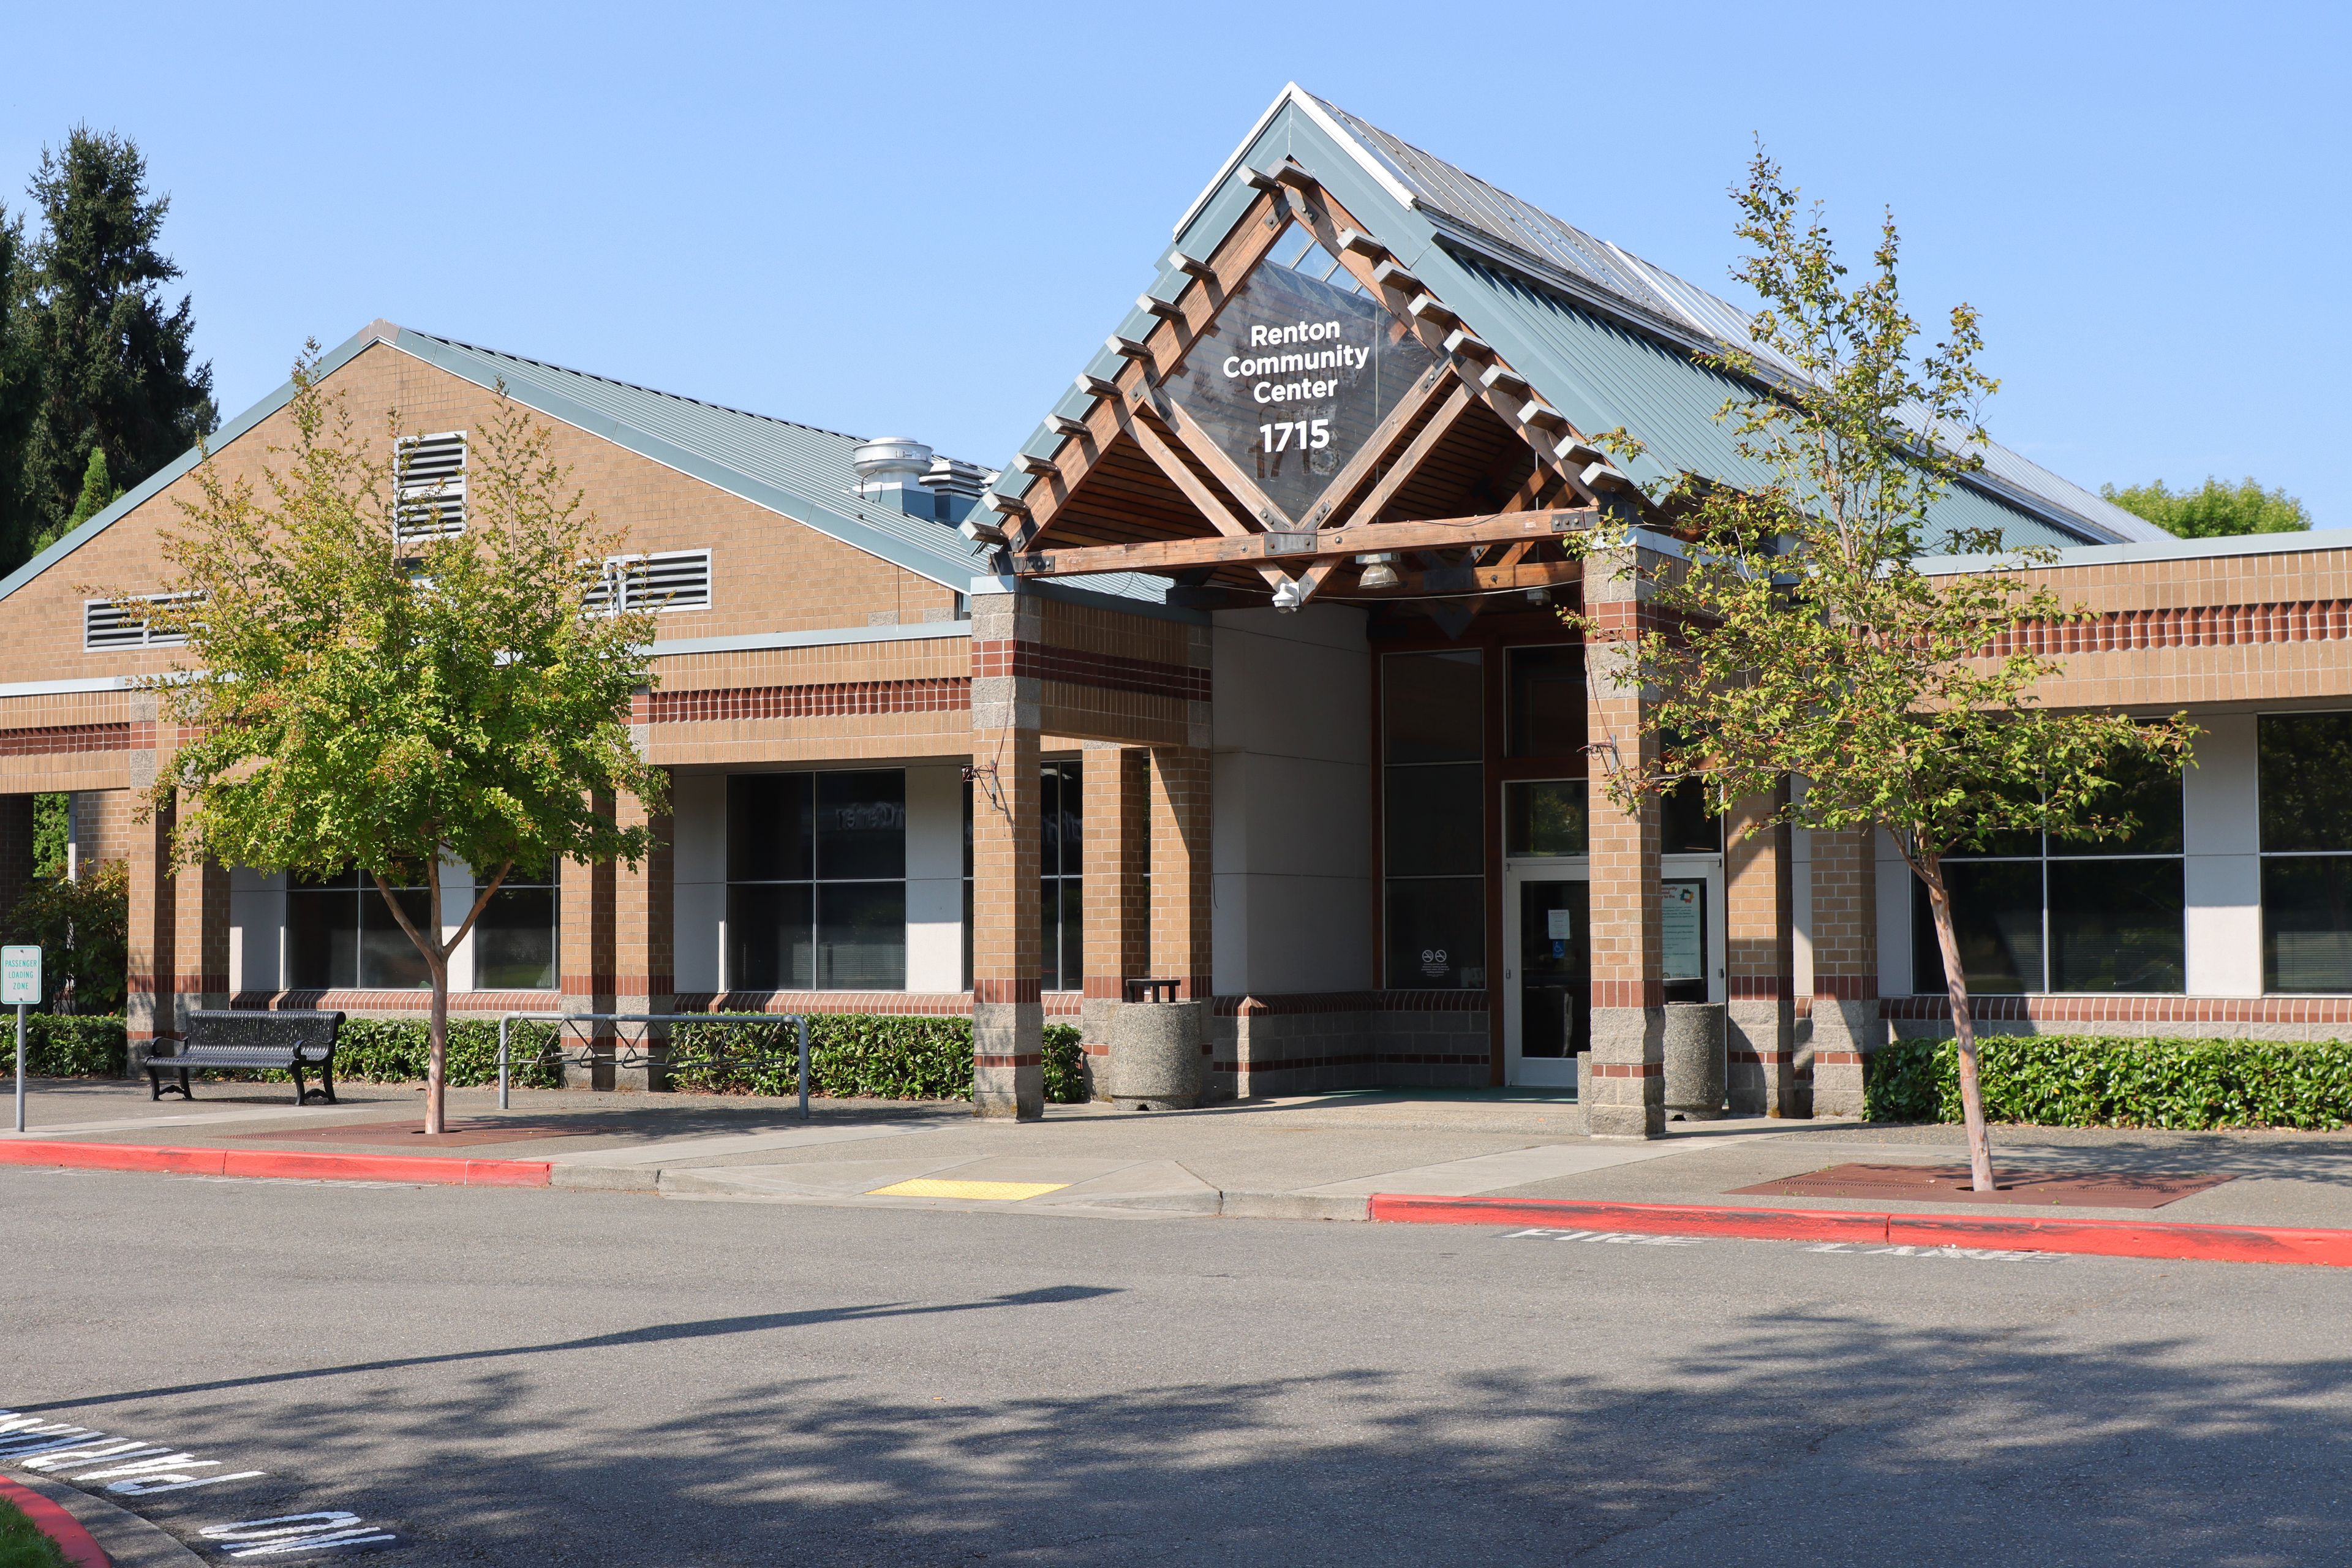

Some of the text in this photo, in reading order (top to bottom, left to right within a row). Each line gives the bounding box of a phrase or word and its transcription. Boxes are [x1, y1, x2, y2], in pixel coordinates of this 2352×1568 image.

[1251, 320, 1340, 347] Renton
[1223, 344, 1370, 379] Community
[1253, 378, 1338, 404] Center
[1259, 418, 1330, 453] 1715
[1501, 1229, 2073, 1263] FIRE LANE
[0, 1409, 266, 1496] PARKI
